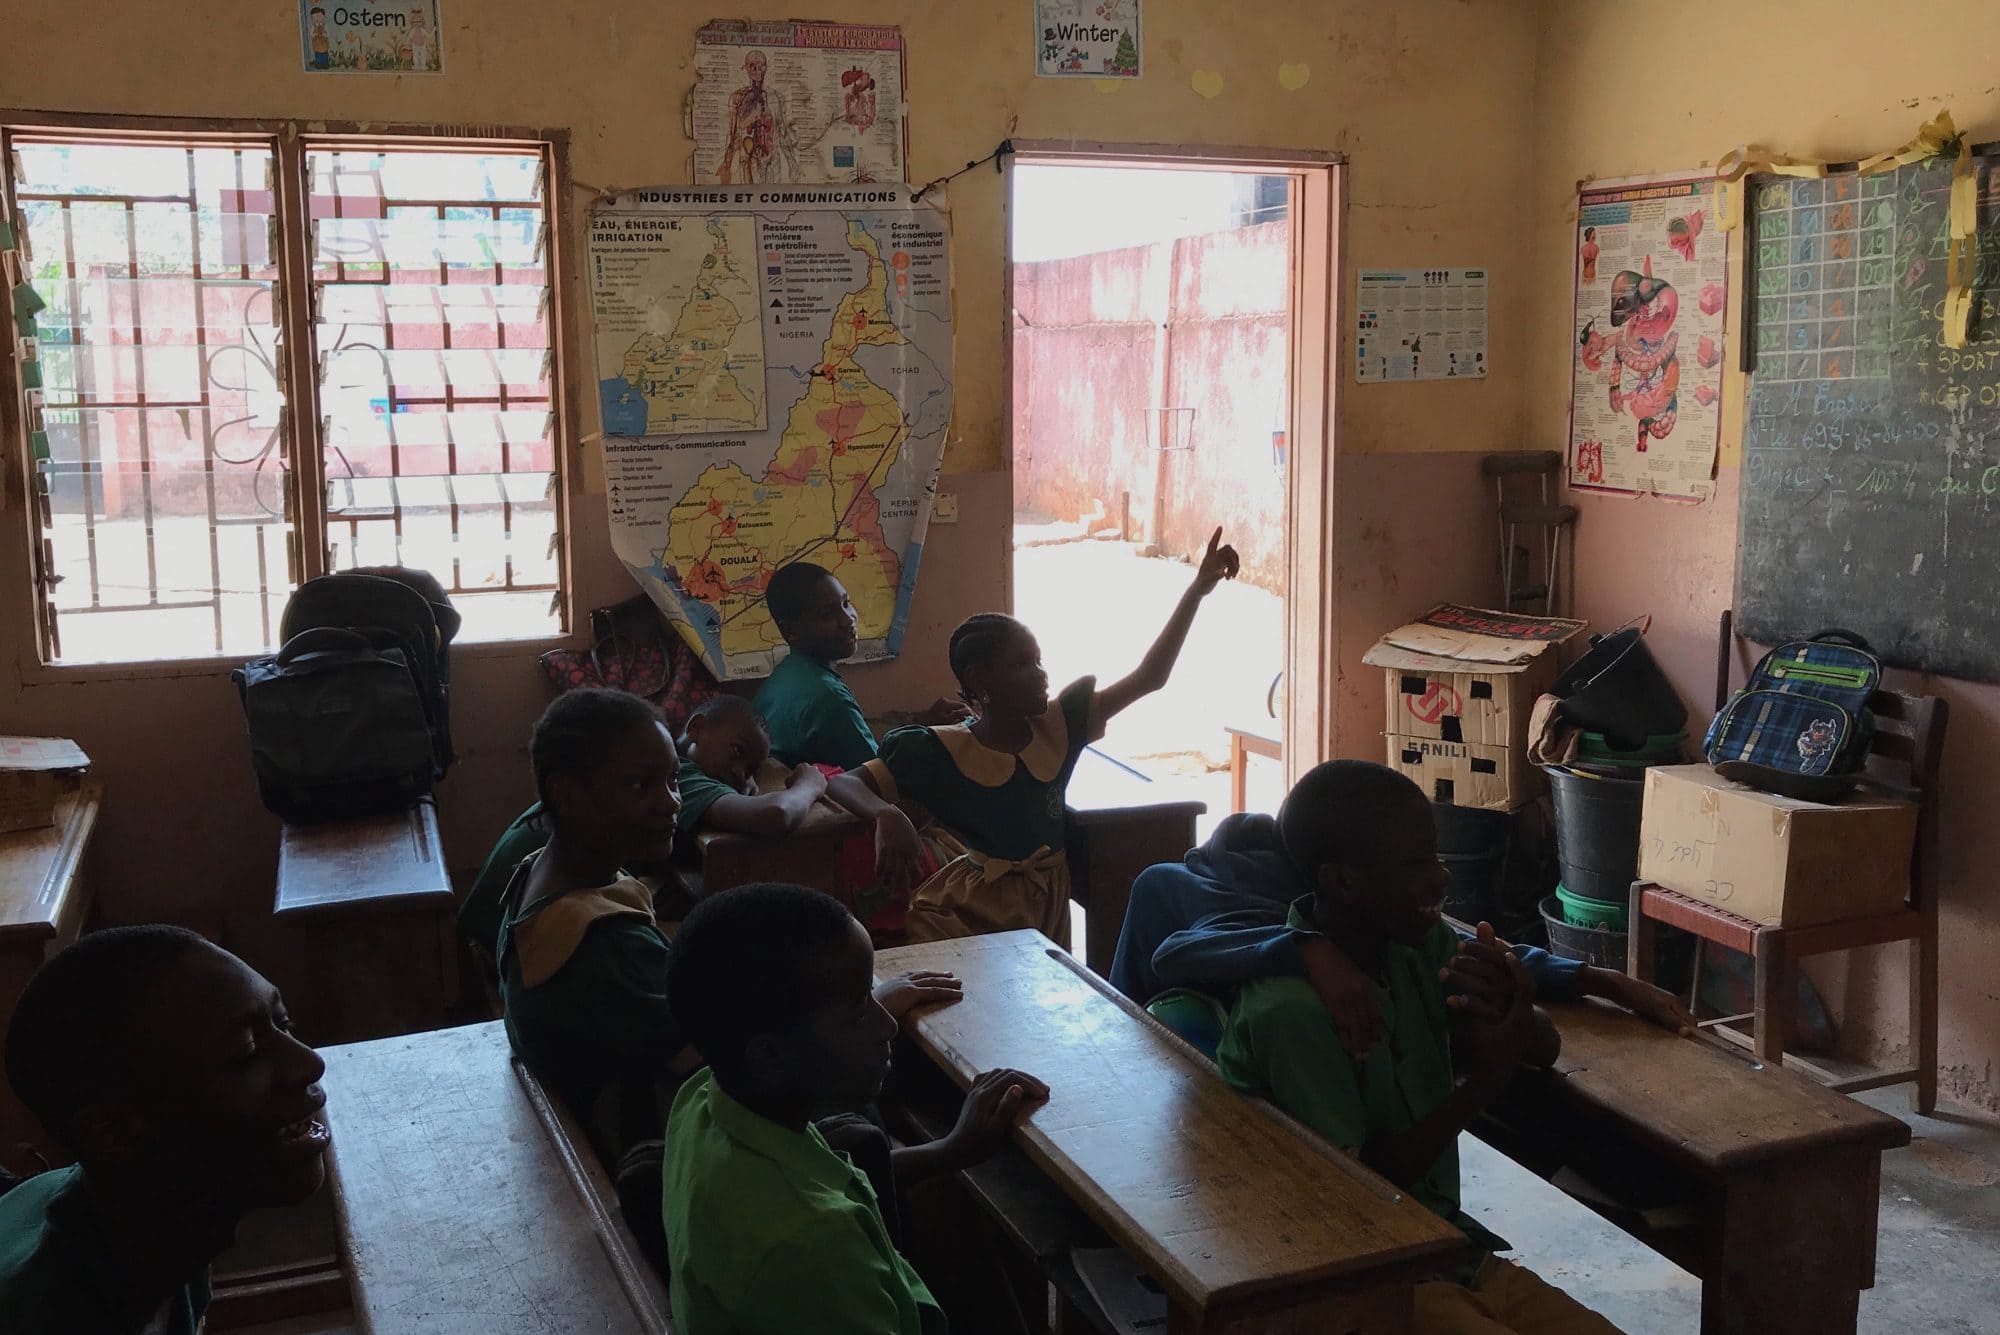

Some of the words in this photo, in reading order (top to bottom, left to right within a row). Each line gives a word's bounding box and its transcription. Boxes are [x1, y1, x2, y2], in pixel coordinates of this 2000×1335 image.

[333, 8, 406, 27] Ostern
[1057, 22, 1119, 43] Winter
[1864, 176, 1889, 198] T
[638, 192, 729, 204] NDUSTRIES
[734, 192, 753, 203] ET
[759, 191, 897, 204] COMMUNICATIONS
[591, 221, 621, 231] EAU,
[625, 219, 682, 231] ÉNERGIE,
[763, 223, 814, 232] Ressources
[891, 222, 921, 231] Centre
[592, 233, 663, 243] IRRIGATION
[763, 233, 802, 241] minières
[891, 230, 943, 240] économique
[775, 241, 818, 251] pétrolière
[892, 240, 901, 249] et
[902, 239, 943, 249] industriel
[779, 331, 815, 340] NIGERIA
[1936, 350, 2000, 374] SPORT
[891, 366, 920, 375] TCHAD
[675, 439, 746, 450] communications
[720, 555, 758, 566] DOUALA
